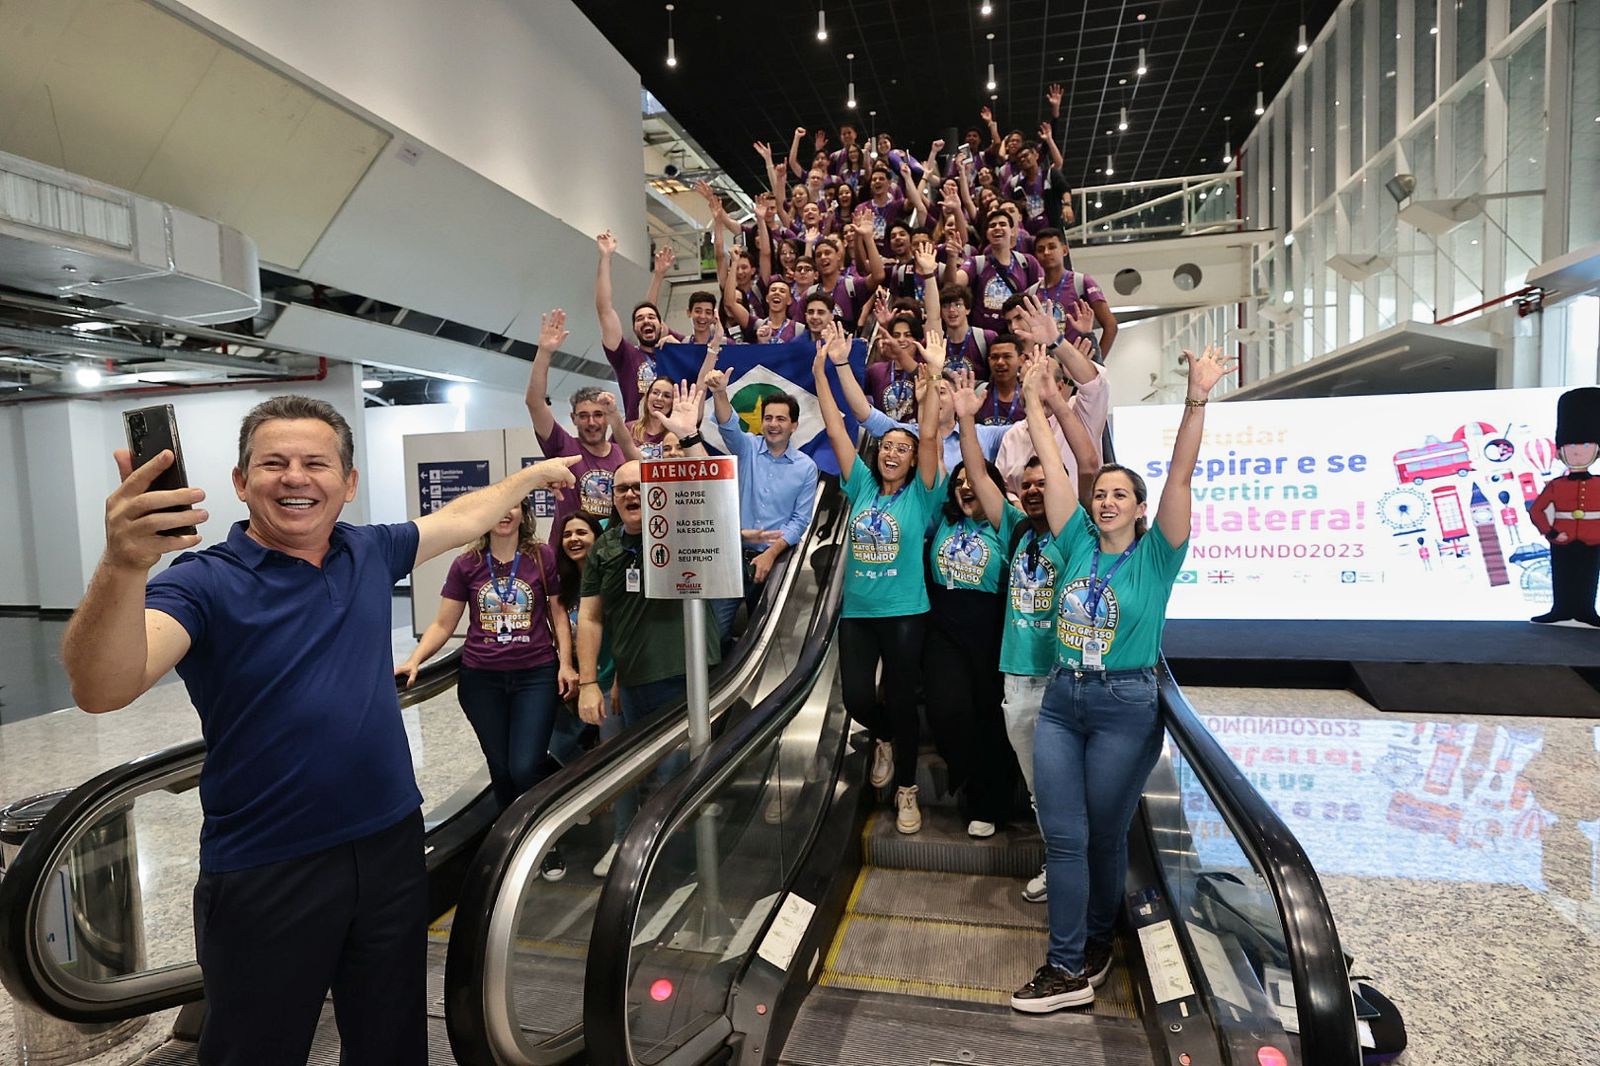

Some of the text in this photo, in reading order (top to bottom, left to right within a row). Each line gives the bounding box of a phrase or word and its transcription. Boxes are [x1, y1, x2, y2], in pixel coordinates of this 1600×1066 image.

[1162, 425, 1288, 447] Etudar
[652, 461, 719, 480] ATENÇÃO
[1146, 450, 1368, 482] sspirar e se
[674, 490, 689, 498] NÃO
[1192, 479, 1318, 501] vertir na
[1190, 501, 1365, 539] glaterra!
[678, 547, 720, 555] ACOMPANHE
[1192, 543, 1365, 559] NOMUNDO2023
